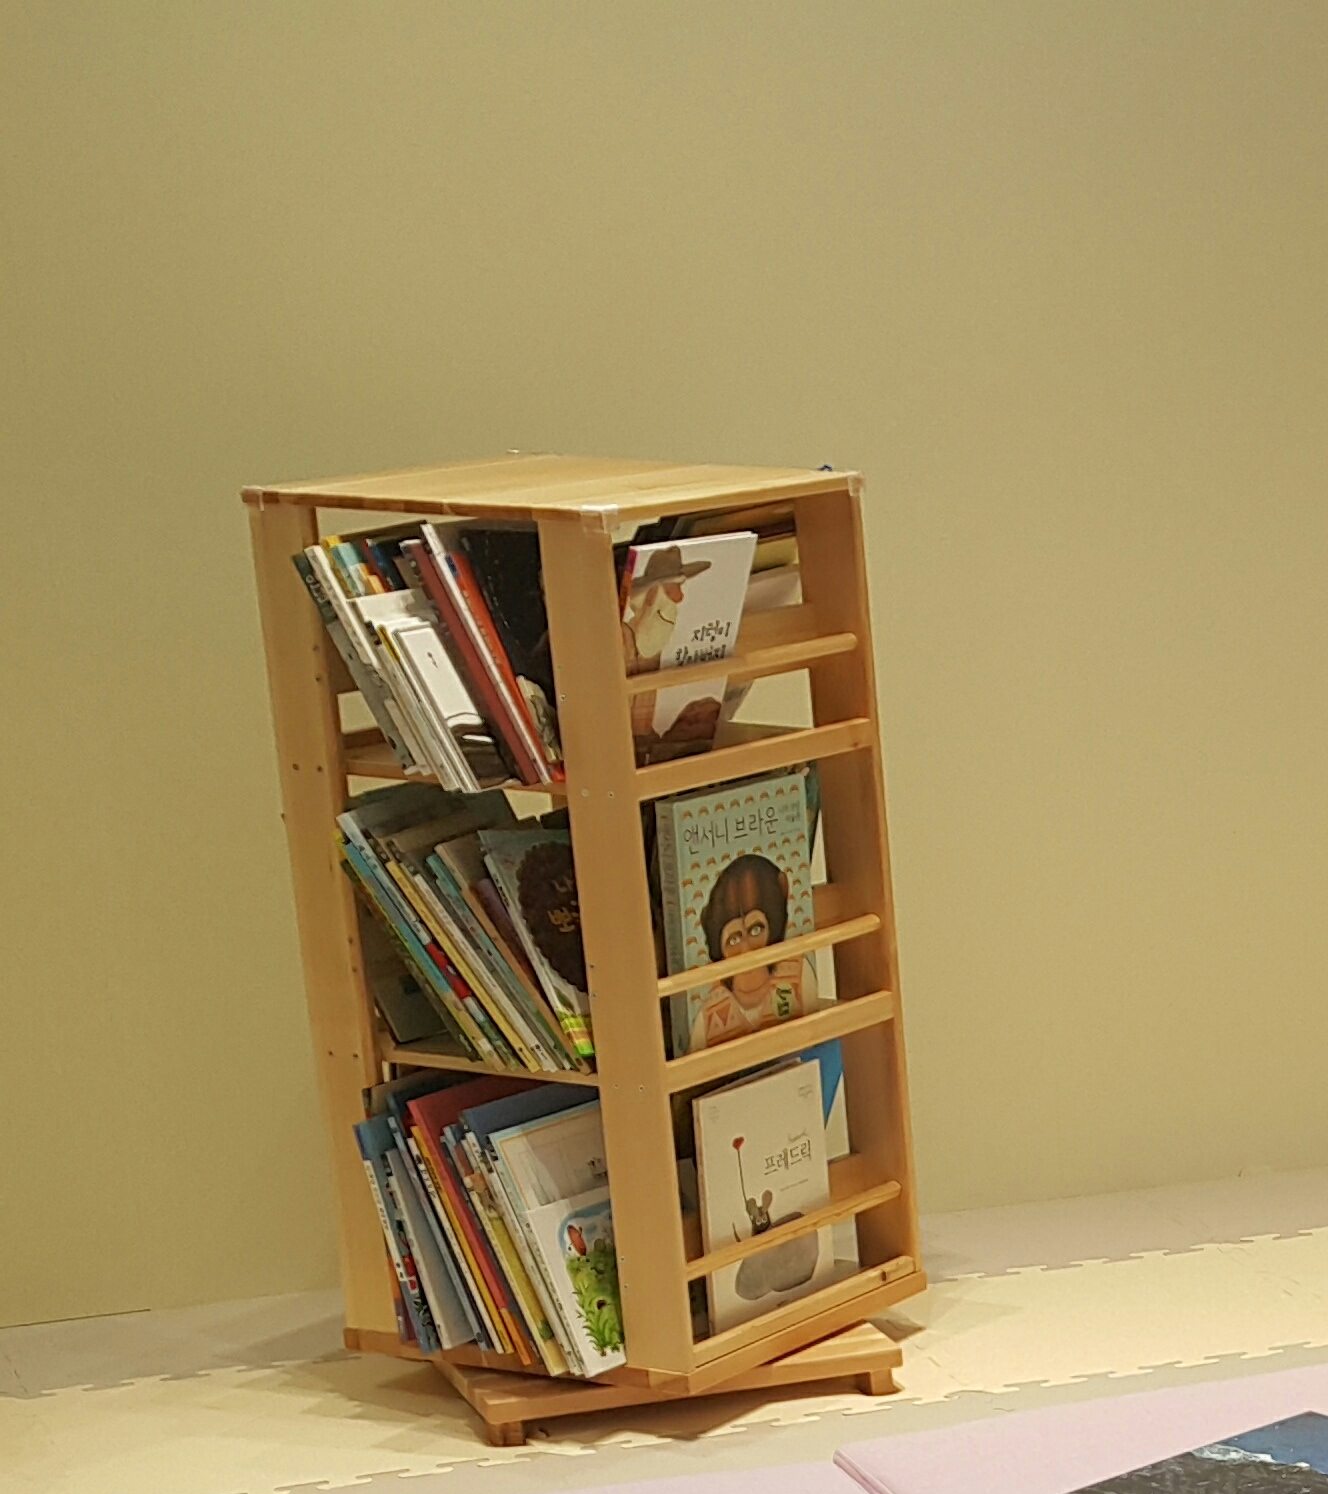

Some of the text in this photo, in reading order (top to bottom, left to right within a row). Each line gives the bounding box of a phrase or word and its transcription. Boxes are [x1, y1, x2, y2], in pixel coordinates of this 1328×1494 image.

[690, 619, 733, 642] 지렁이
[683, 816, 730, 855] 앤서니
[734, 806, 779, 839] 브라운
[763, 1139, 813, 1176] 프레드릭
